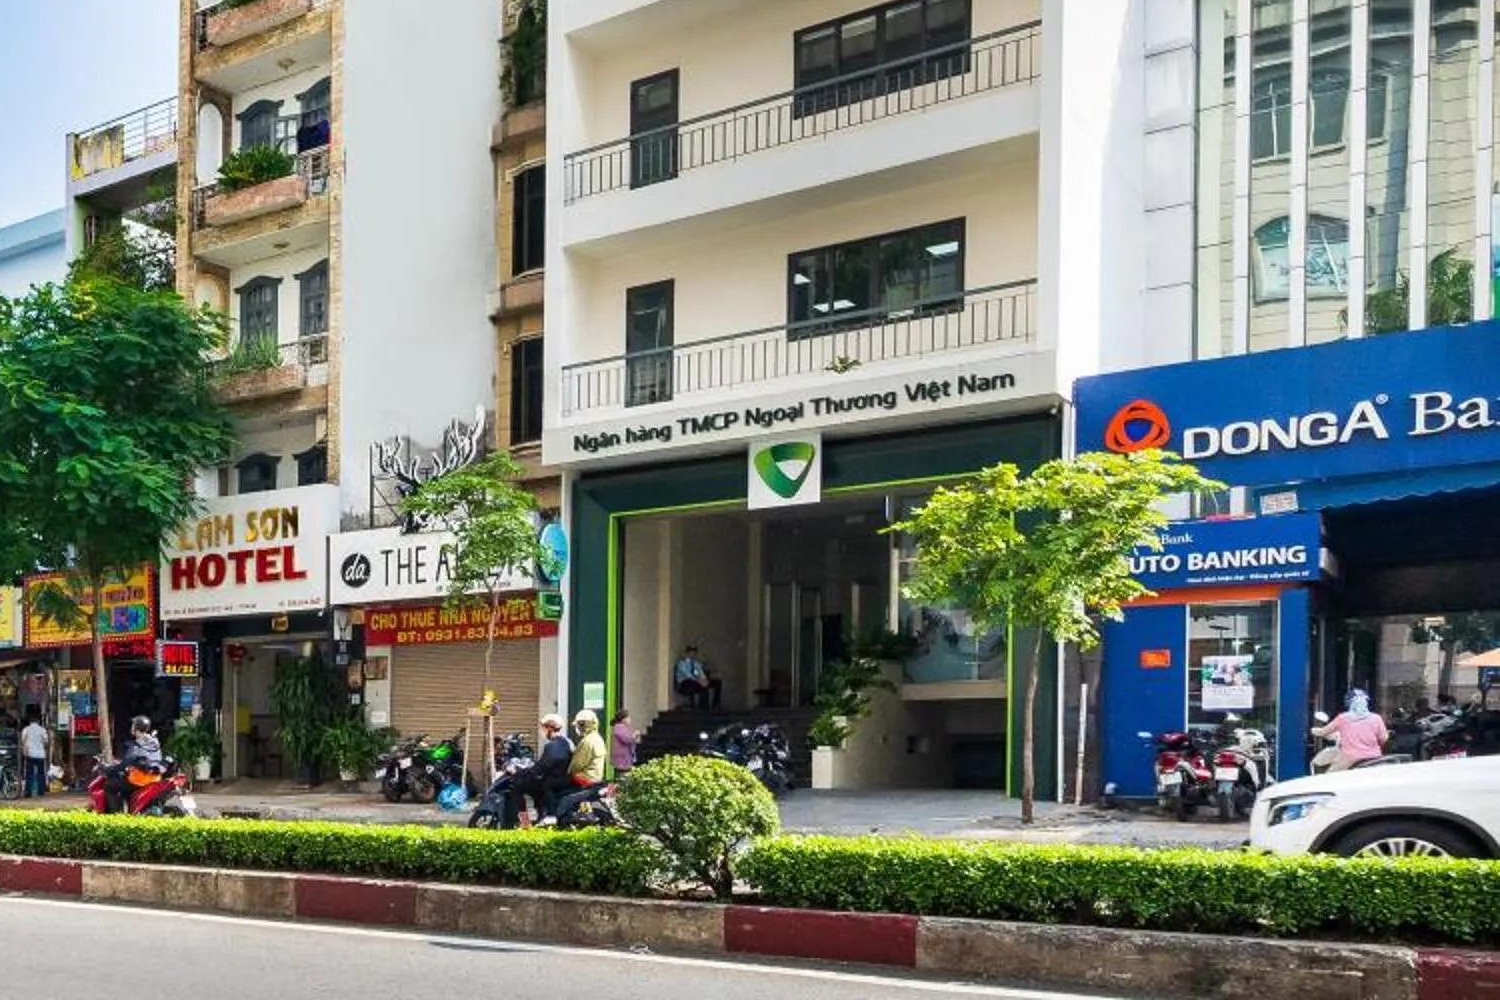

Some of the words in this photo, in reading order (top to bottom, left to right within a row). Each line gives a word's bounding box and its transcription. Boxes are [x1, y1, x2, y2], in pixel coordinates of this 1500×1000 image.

[574, 432, 621, 452] Ngân
[625, 425, 672, 443] hàng
[677, 411, 738, 435] TMCP
[745, 400, 804, 428] Ngoại
[811, 390, 897, 416] Thương
[905, 380, 952, 402] Việt
[957, 372, 1016, 395] Nam
[1407, 391, 1500, 436] Ba
[1161, 532, 1194, 545] Bank
[171, 546, 307, 590] HOTEL
[380, 546, 427, 587] THE
[1125, 553, 1181, 575] UTO
[1187, 545, 1307, 571] BANKING
[370, 612, 398, 631] CHO
